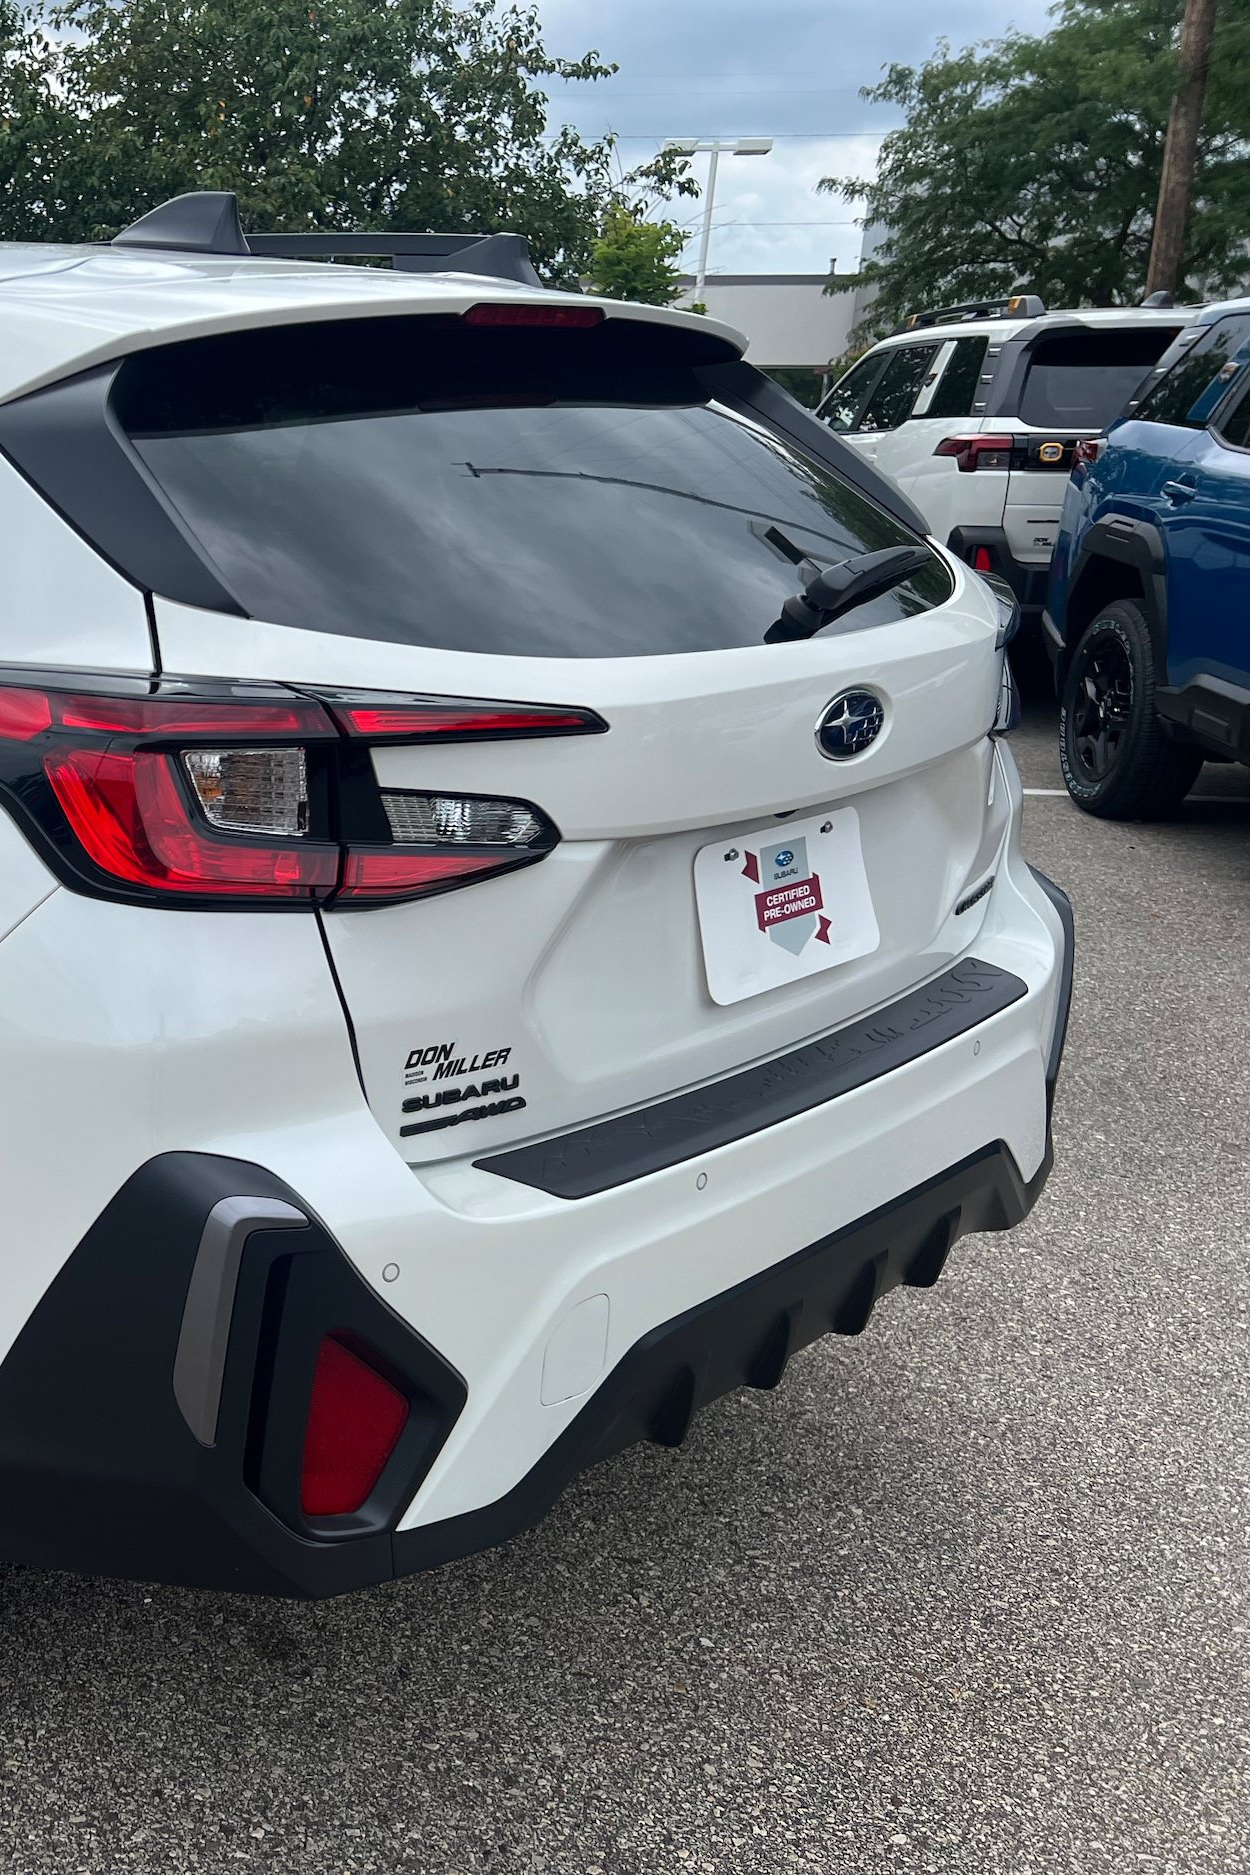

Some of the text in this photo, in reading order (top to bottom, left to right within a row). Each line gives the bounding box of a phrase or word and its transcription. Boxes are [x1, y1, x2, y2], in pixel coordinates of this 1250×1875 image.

[773, 868, 798, 879] SUBARU
[763, 896, 816, 921] PRE-OWNED
[766, 885, 810, 906] CERTIFIED
[404, 1042, 455, 1070] DON
[432, 1047, 511, 1080] MILLER
[401, 1073, 520, 1113] SUBARU
[449, 1096, 527, 1126] AWD
